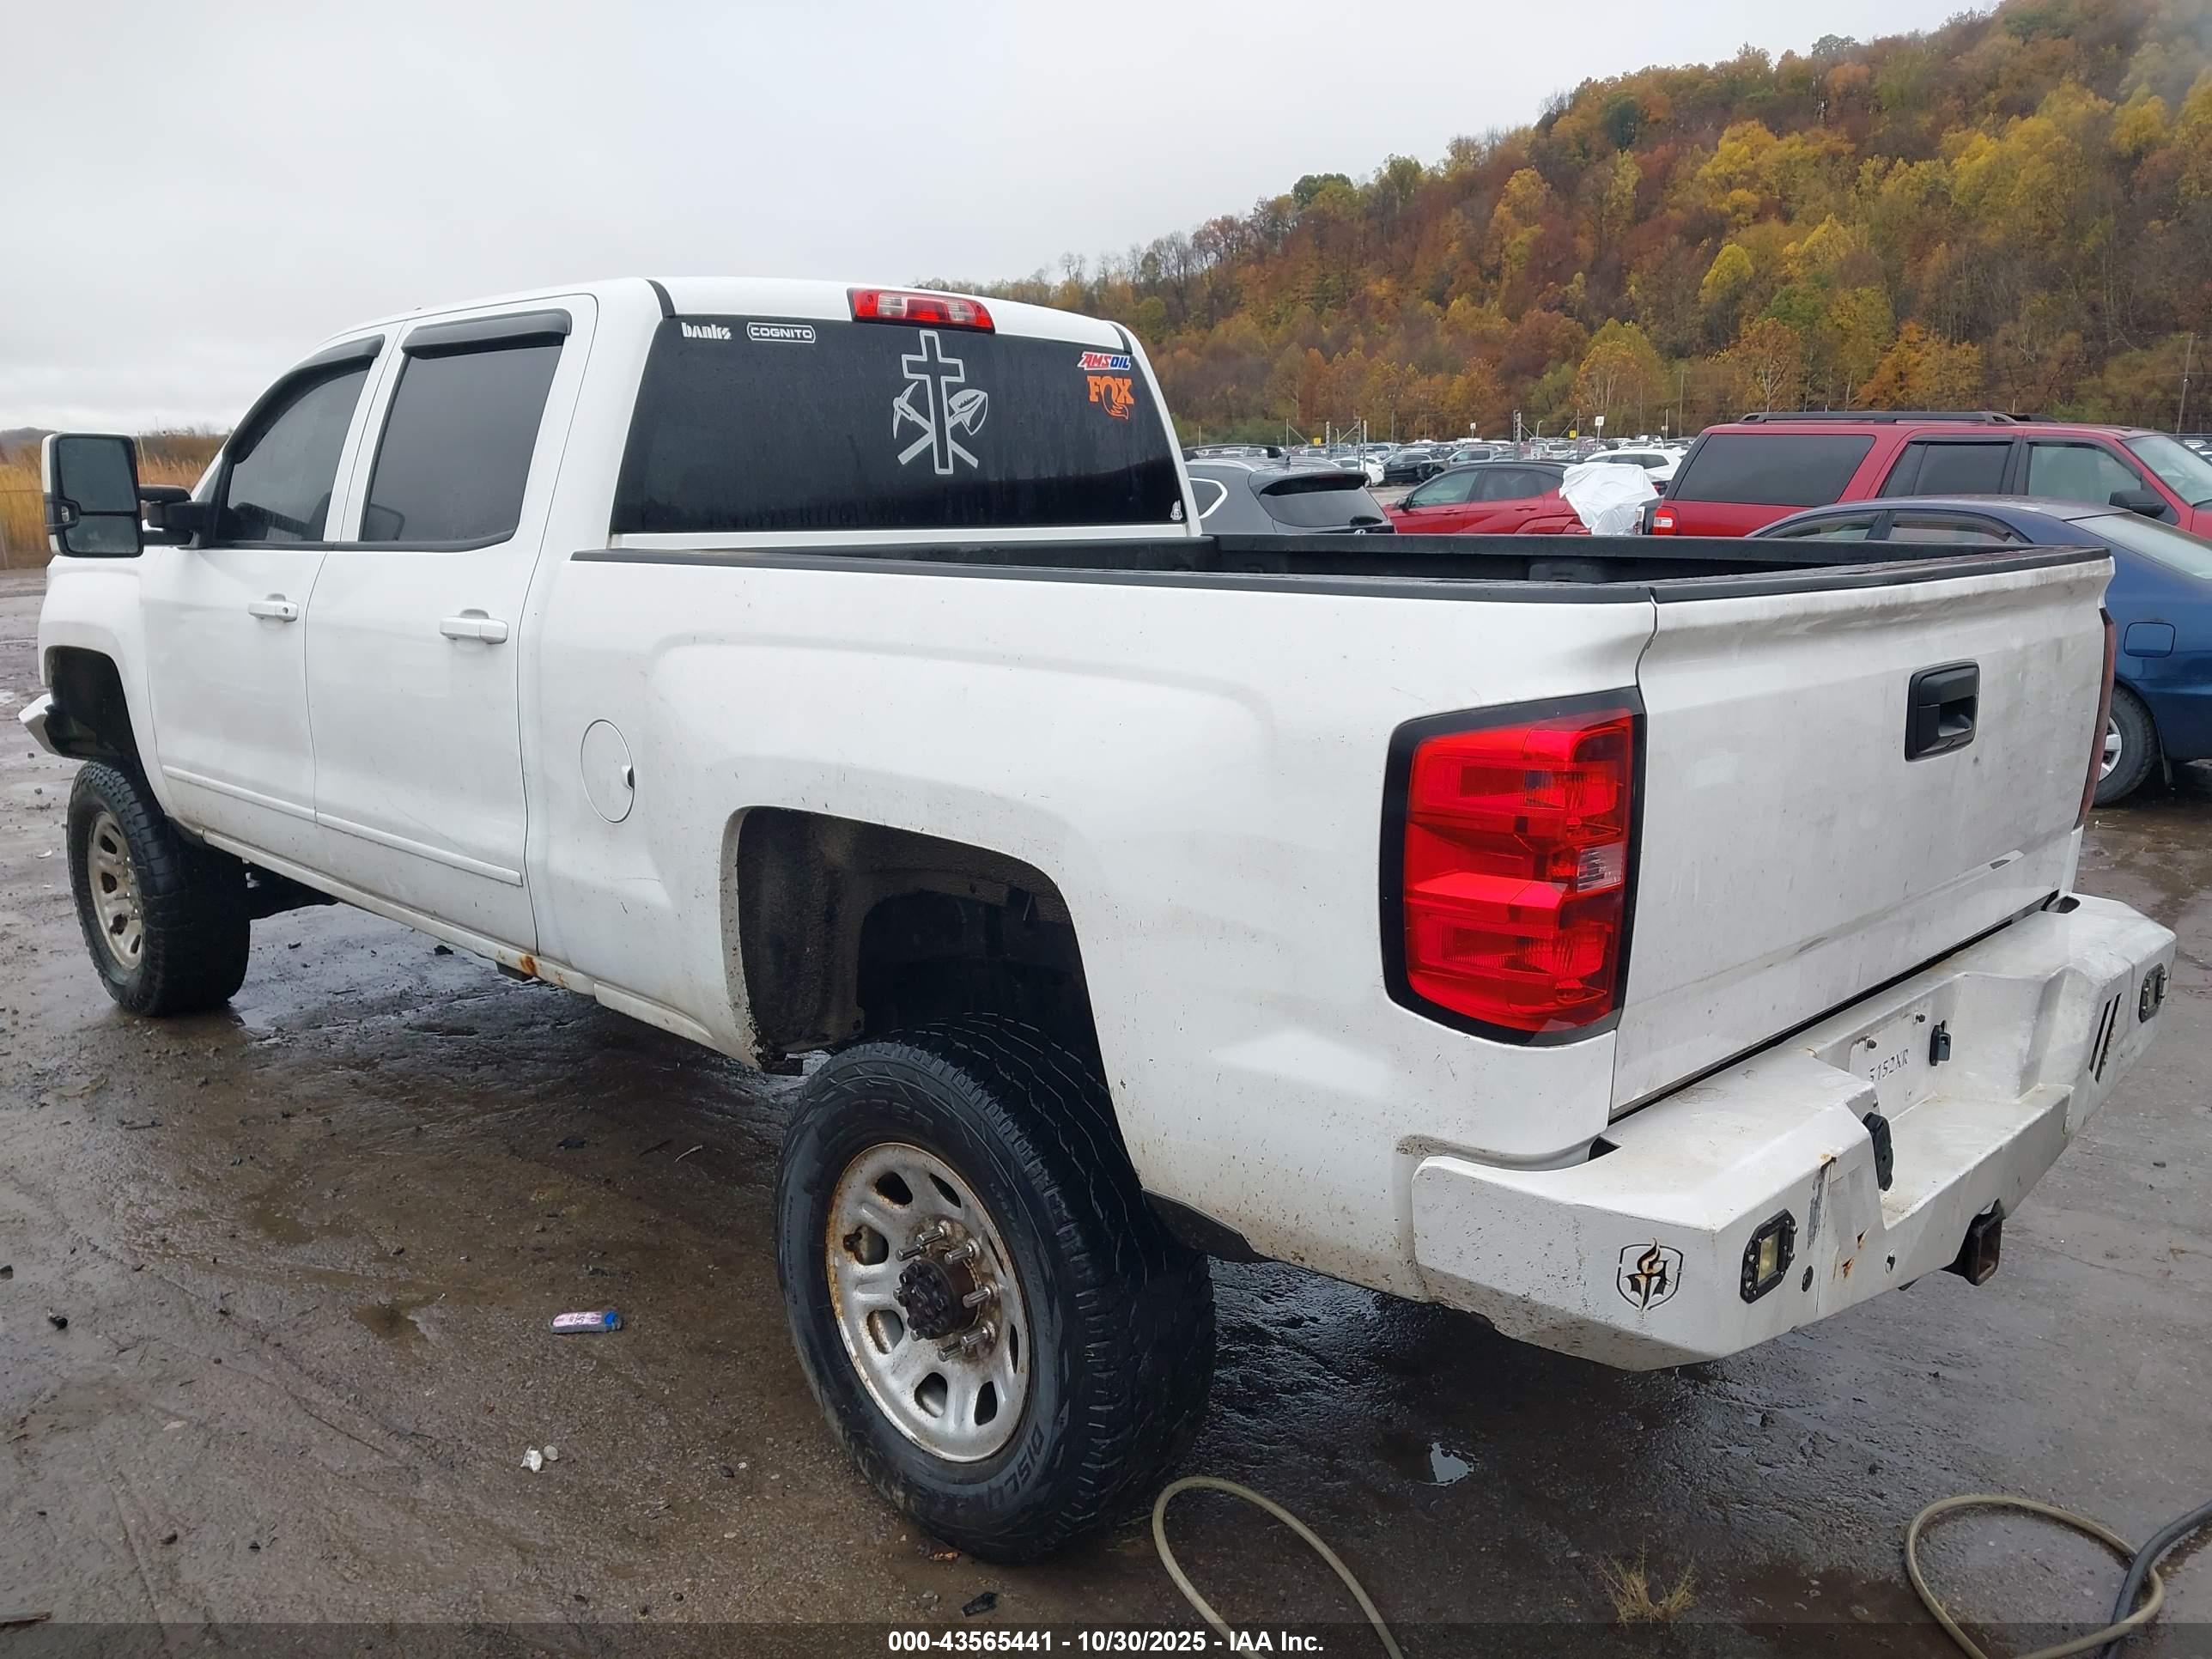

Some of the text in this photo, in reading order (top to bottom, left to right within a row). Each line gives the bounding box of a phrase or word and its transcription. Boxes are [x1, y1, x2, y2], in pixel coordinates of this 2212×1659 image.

[750, 326, 813, 339] COGNITO
[1080, 353, 1130, 369] AMSOIL
[1086, 375, 1133, 419] FOX
